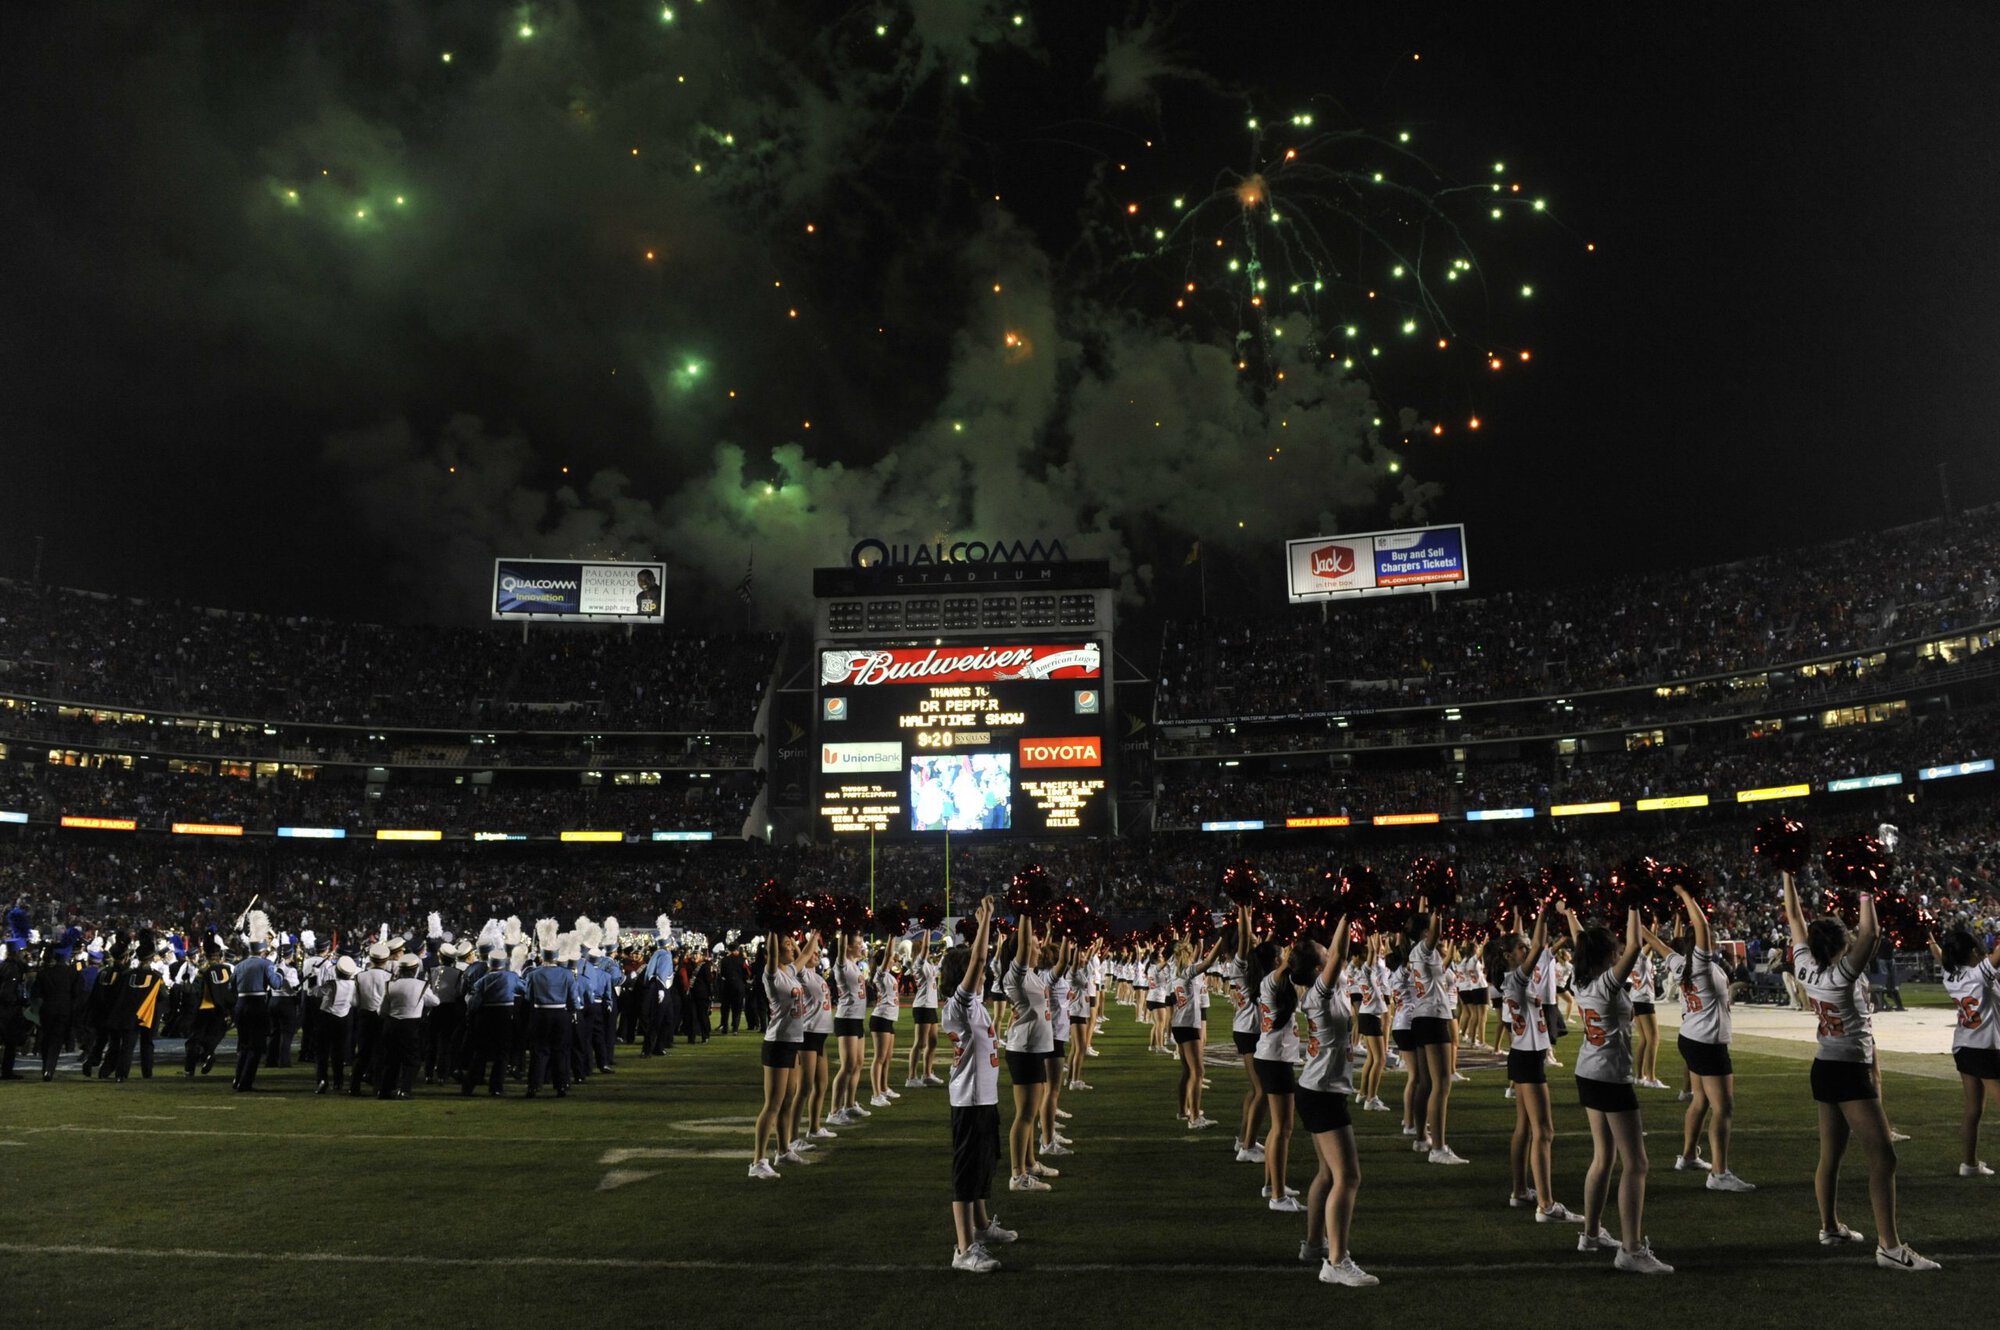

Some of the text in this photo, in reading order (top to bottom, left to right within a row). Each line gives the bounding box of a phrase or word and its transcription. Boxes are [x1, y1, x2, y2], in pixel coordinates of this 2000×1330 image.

[851, 538, 1067, 574] QUALCOMM
[1313, 549, 1353, 575] Jack
[1391, 547, 1444, 562] Buy and Sell
[1381, 557, 1457, 573] Chargers Tickets!
[585, 569, 636, 578] PALOMAR
[897, 569, 1051, 584] STADIUM
[502, 576, 577, 592] QUALCOMM
[585, 578, 636, 587] POMERADO
[516, 593, 565, 602] Innovation
[584, 586, 637, 595] HEALTH
[588, 604, 631, 612] www.pph.org
[847, 646, 1033, 686] Budweiser
[1035, 654, 1098, 673] American Lager
[929, 688, 971, 698] THANKS
[920, 699, 999, 712] DR PEPPER
[900, 712, 1025, 728] HALFTIME SHOW
[842, 751, 900, 763] UnionBank
[1023, 744, 1097, 761] TOYOTA
[1040, 781, 1079, 789] PACIFIC
[1081, 780, 1104, 788] LIFE
[1287, 817, 1348, 827] WELLS FARGO
[128, 973, 153, 989] U
[210, 967, 230, 985] U
